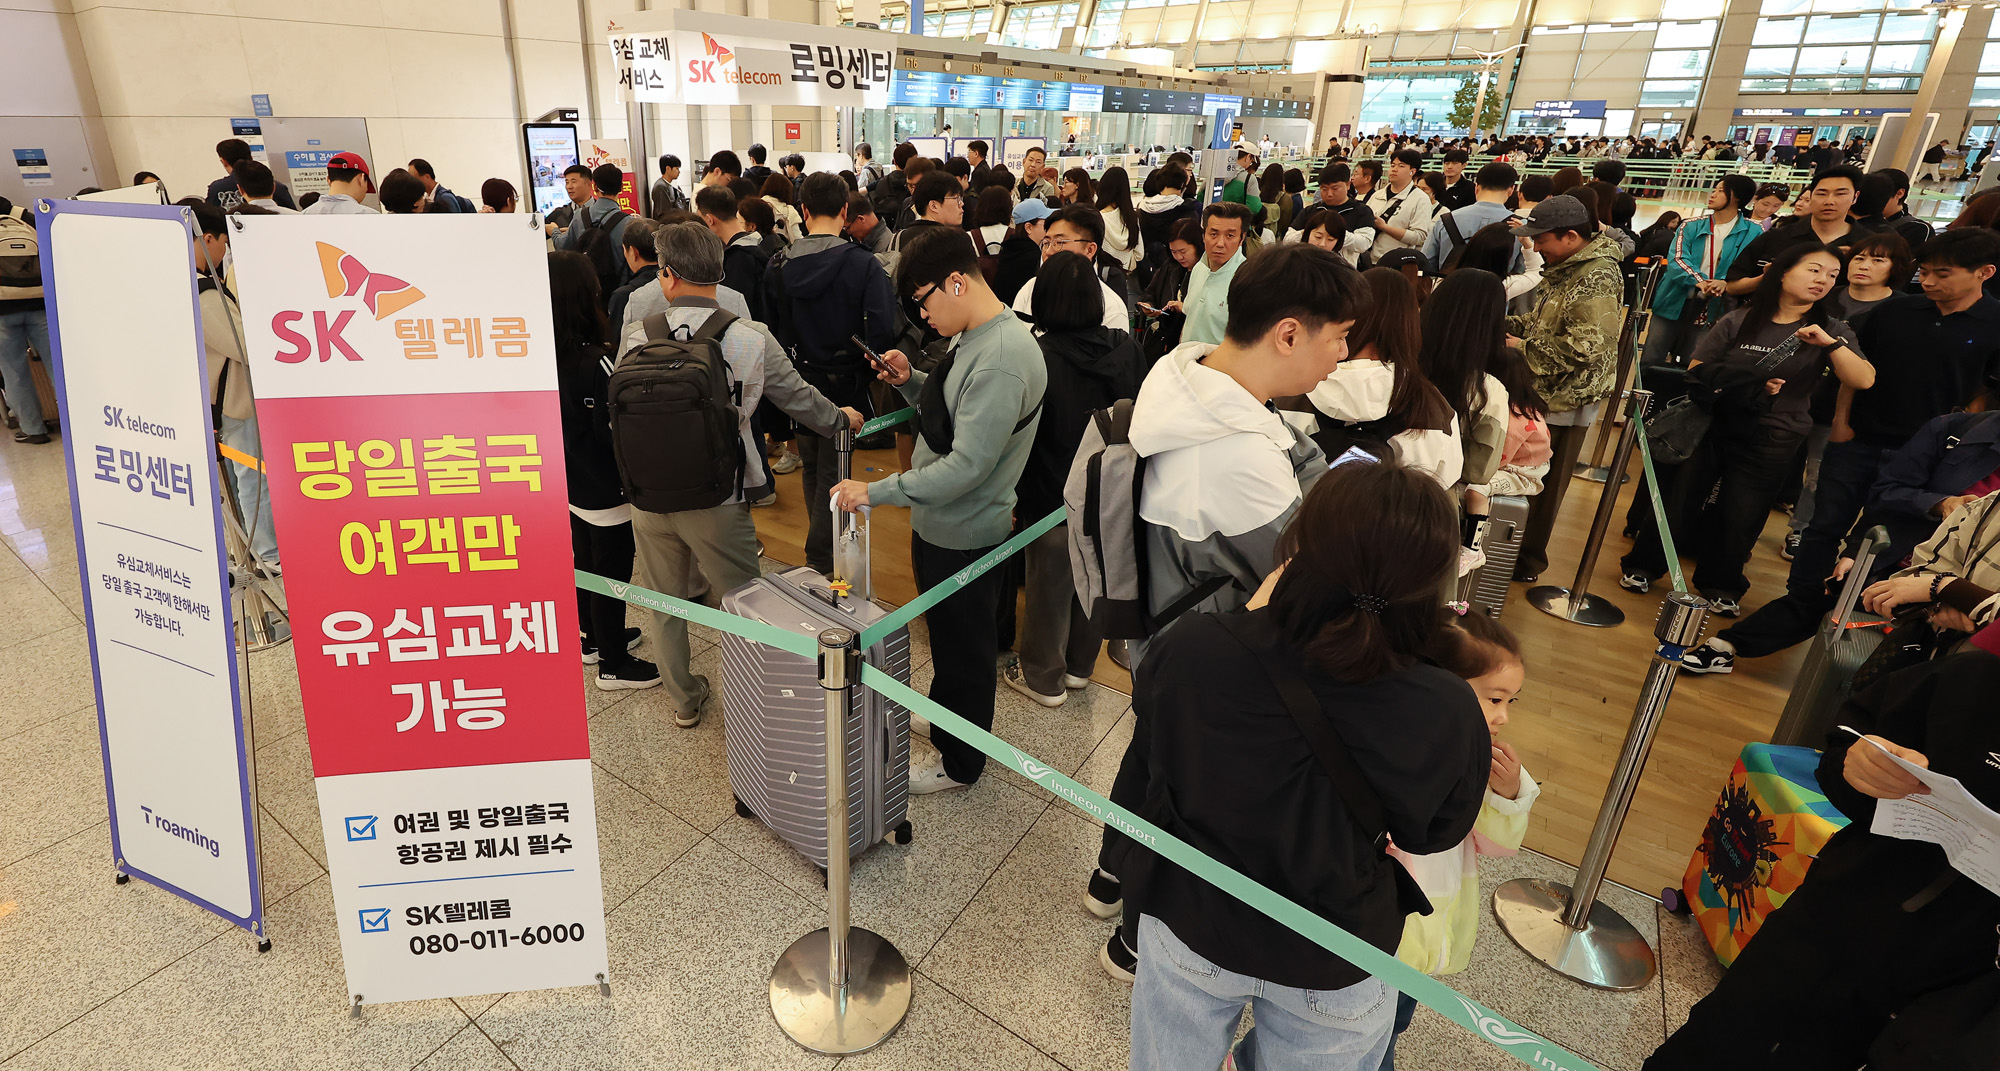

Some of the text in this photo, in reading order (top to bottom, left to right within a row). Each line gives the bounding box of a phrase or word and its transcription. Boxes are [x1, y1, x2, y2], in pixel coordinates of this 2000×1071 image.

[639, 37, 671, 61] 교체
[905, 57, 919, 69] F16
[619, 67, 664, 91] 서비스
[688, 59, 716, 83] SK
[723, 65, 782, 86] telecom
[789, 43, 892, 92] 로밍센터
[972, 63, 984, 74] F15
[1054, 71, 1065, 81] F13
[586, 157, 601, 169] SK
[271, 309, 532, 364] SK 텔레콤
[103, 404, 176, 441] SK telecom
[863, 417, 896, 434] Incheon Airport
[94, 444, 195, 507] 로밍센터
[291, 433, 544, 501] 당일출국
[338, 513, 522, 577] 여객만
[972, 545, 1014, 577] Incheon Airport
[116, 553, 192, 589] 유심교체서비스는
[102, 573, 210, 622] 당일 출국 고객에 한해서만
[629, 591, 689, 617] Incheon Airport
[134, 608, 185, 637] 가능합니다.
[320, 600, 560, 668] 유심교체
[390, 678, 508, 734] 가능
[393, 802, 570, 834] 여권 및 당일출국
[1050, 778, 1158, 847] Incheon Airport
[1723, 816, 1733, 833] Go
[140, 804, 220, 858] T roaming
[1731, 828, 1753, 862] Travel
[396, 833, 573, 866] 항공권 제시 필수
[1720, 833, 1742, 868] Europe
[405, 898, 512, 926] SK텔레콤
[409, 922, 585, 956] 080-011-6000
